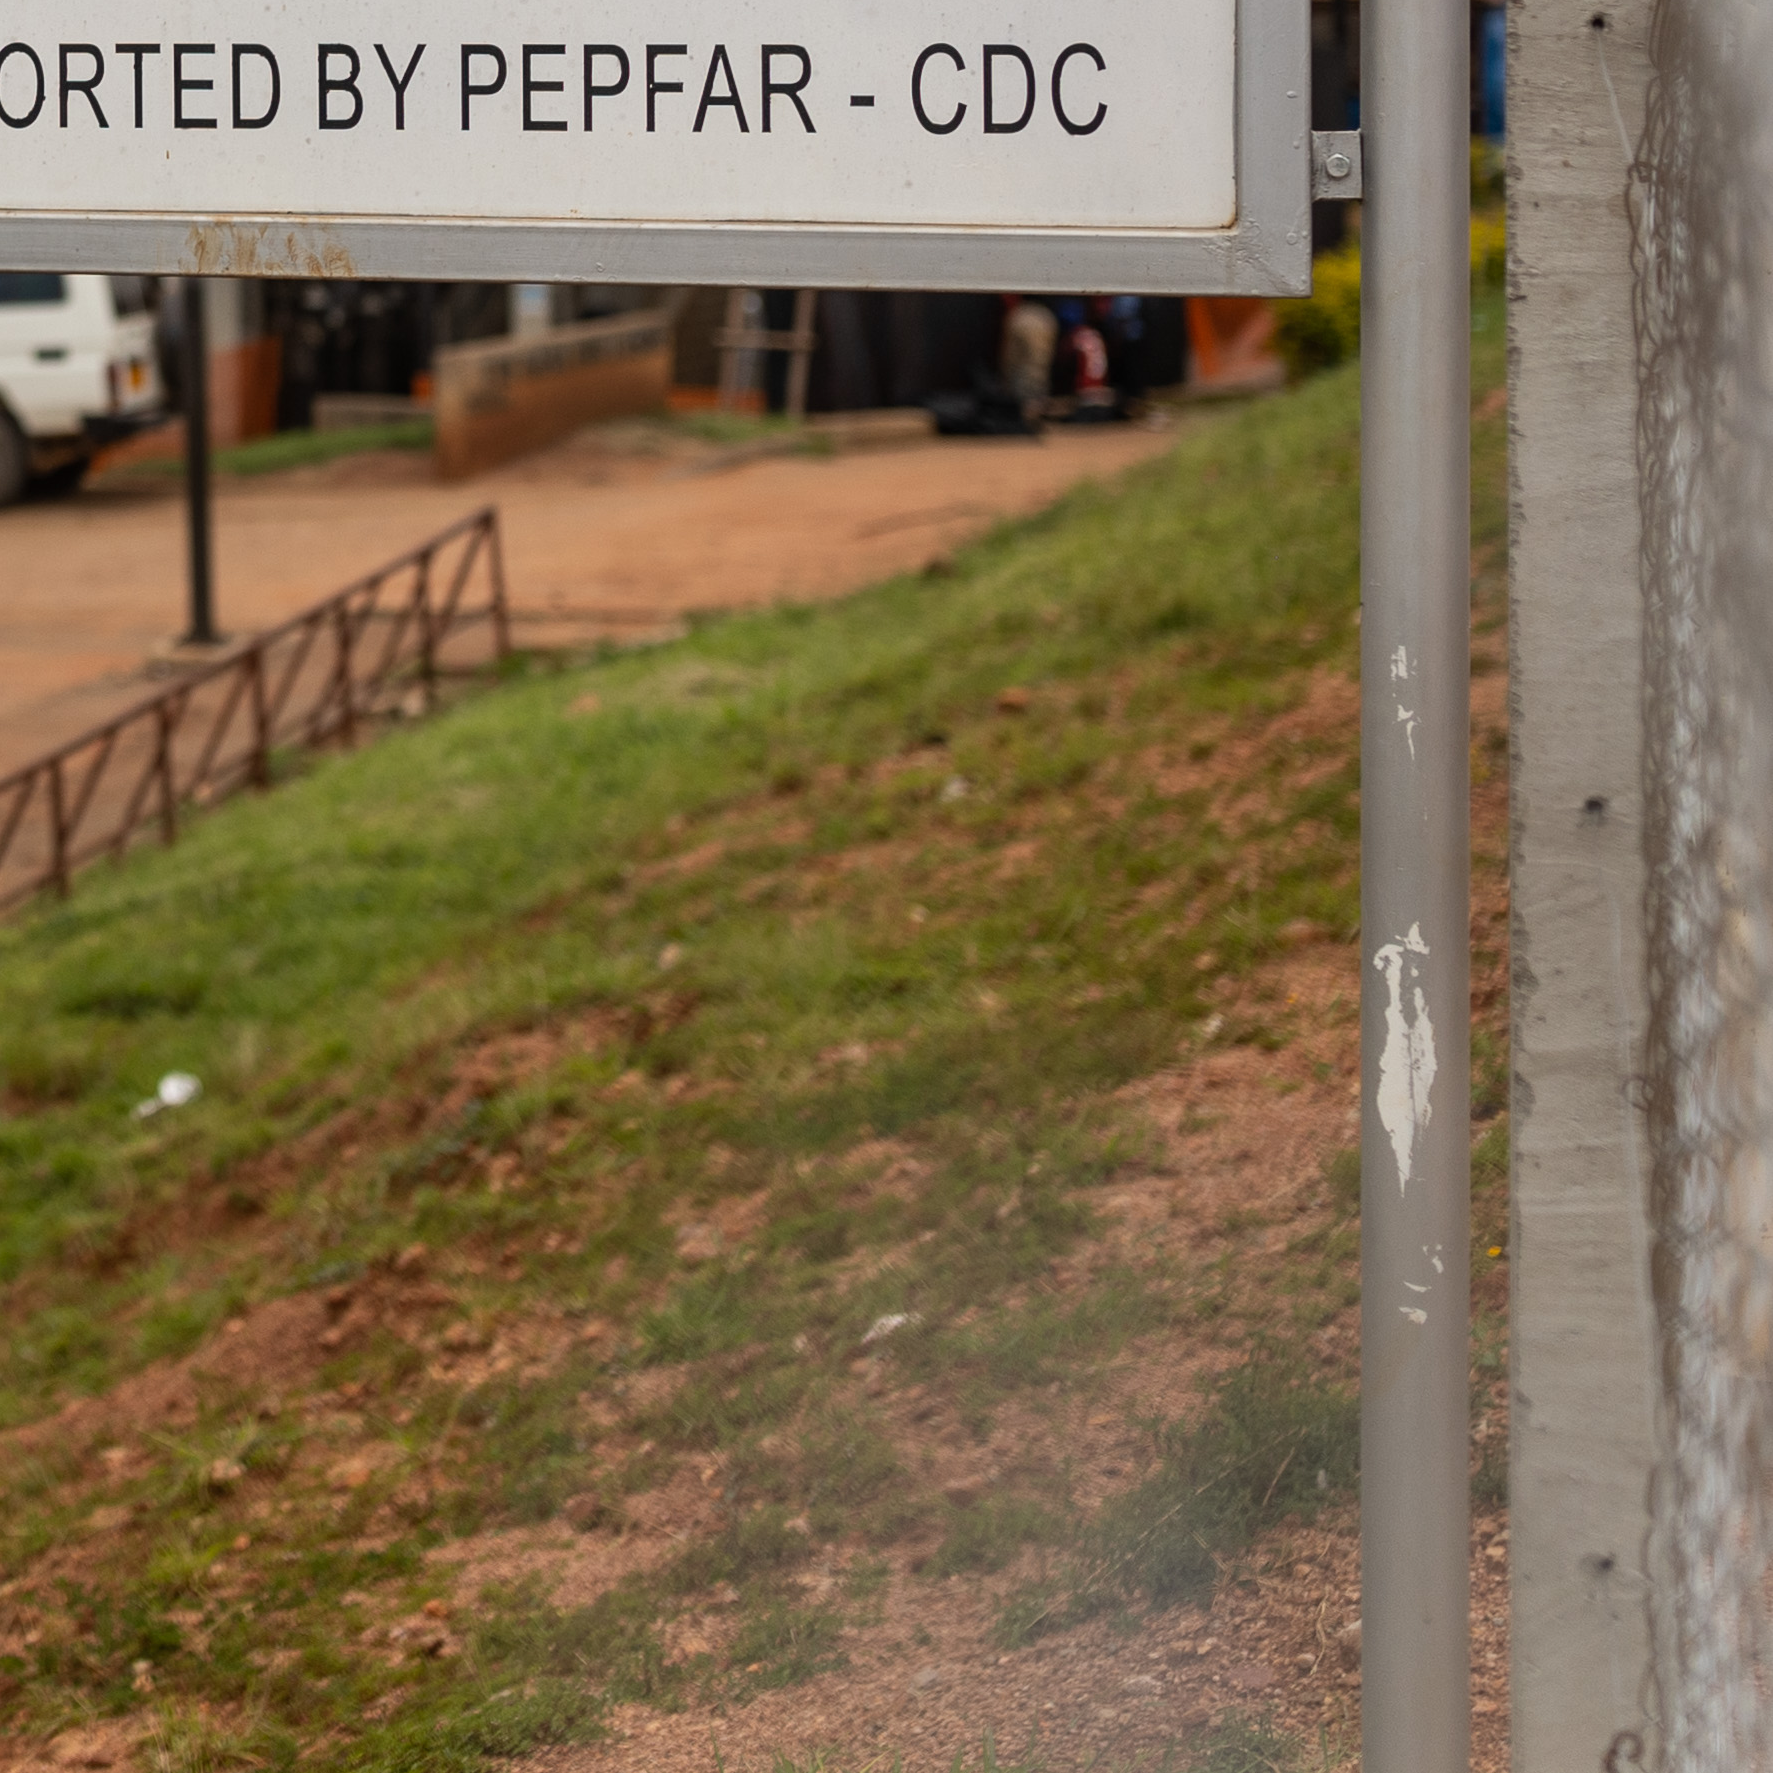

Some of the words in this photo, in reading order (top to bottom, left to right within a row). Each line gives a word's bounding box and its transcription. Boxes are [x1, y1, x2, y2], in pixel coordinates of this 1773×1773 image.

[318, 44, 426, 130] BY
[461, 44, 816, 133] PEPFAR
[912, 43, 1107, 135] CDC
